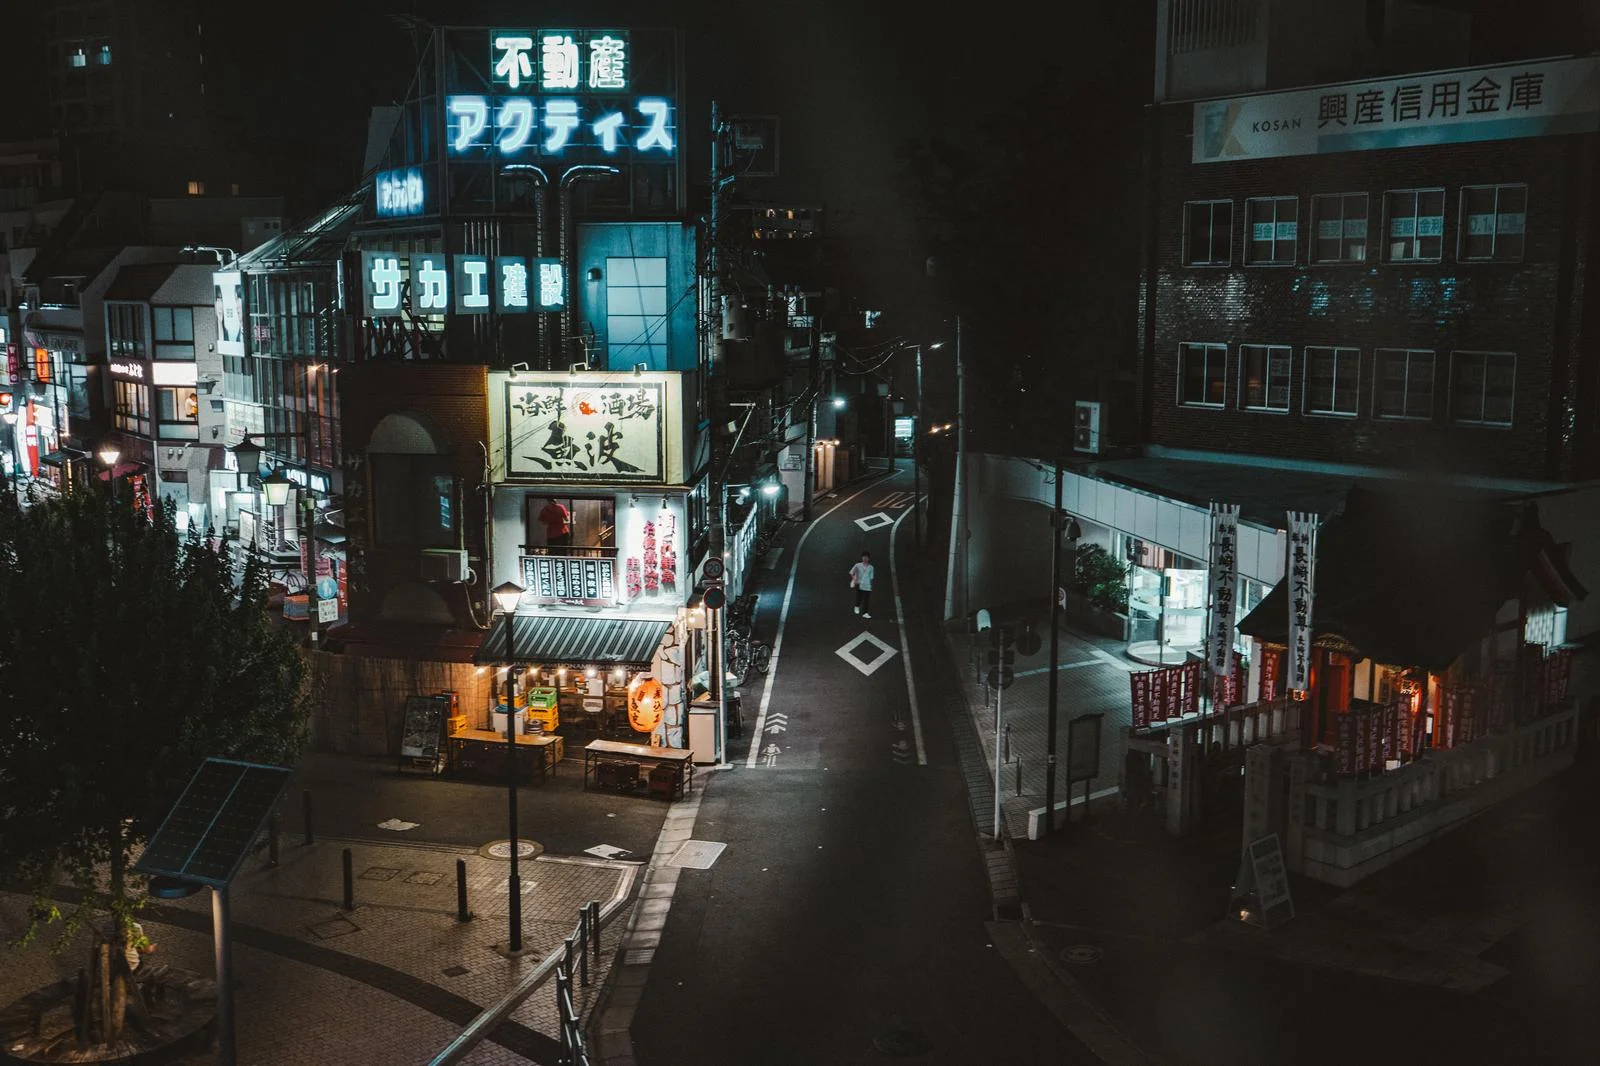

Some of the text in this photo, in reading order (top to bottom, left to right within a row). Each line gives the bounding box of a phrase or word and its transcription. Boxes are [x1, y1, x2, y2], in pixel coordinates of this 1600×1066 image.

[494, 35, 626, 89] 不動産
[449, 97, 674, 153] アクティス
[1251, 117, 1303, 134] KOSAN
[1317, 72, 1545, 129] 興産信用金庫
[371, 258, 565, 310] サカエ建設
[513, 388, 656, 422] 海鮮 酒場
[522, 420, 647, 473] 魚波
[708, 563, 720, 573] 20
[1216, 537, 1234, 620] 長崎不動尊
[1293, 547, 1310, 632] 長崎不動尊
